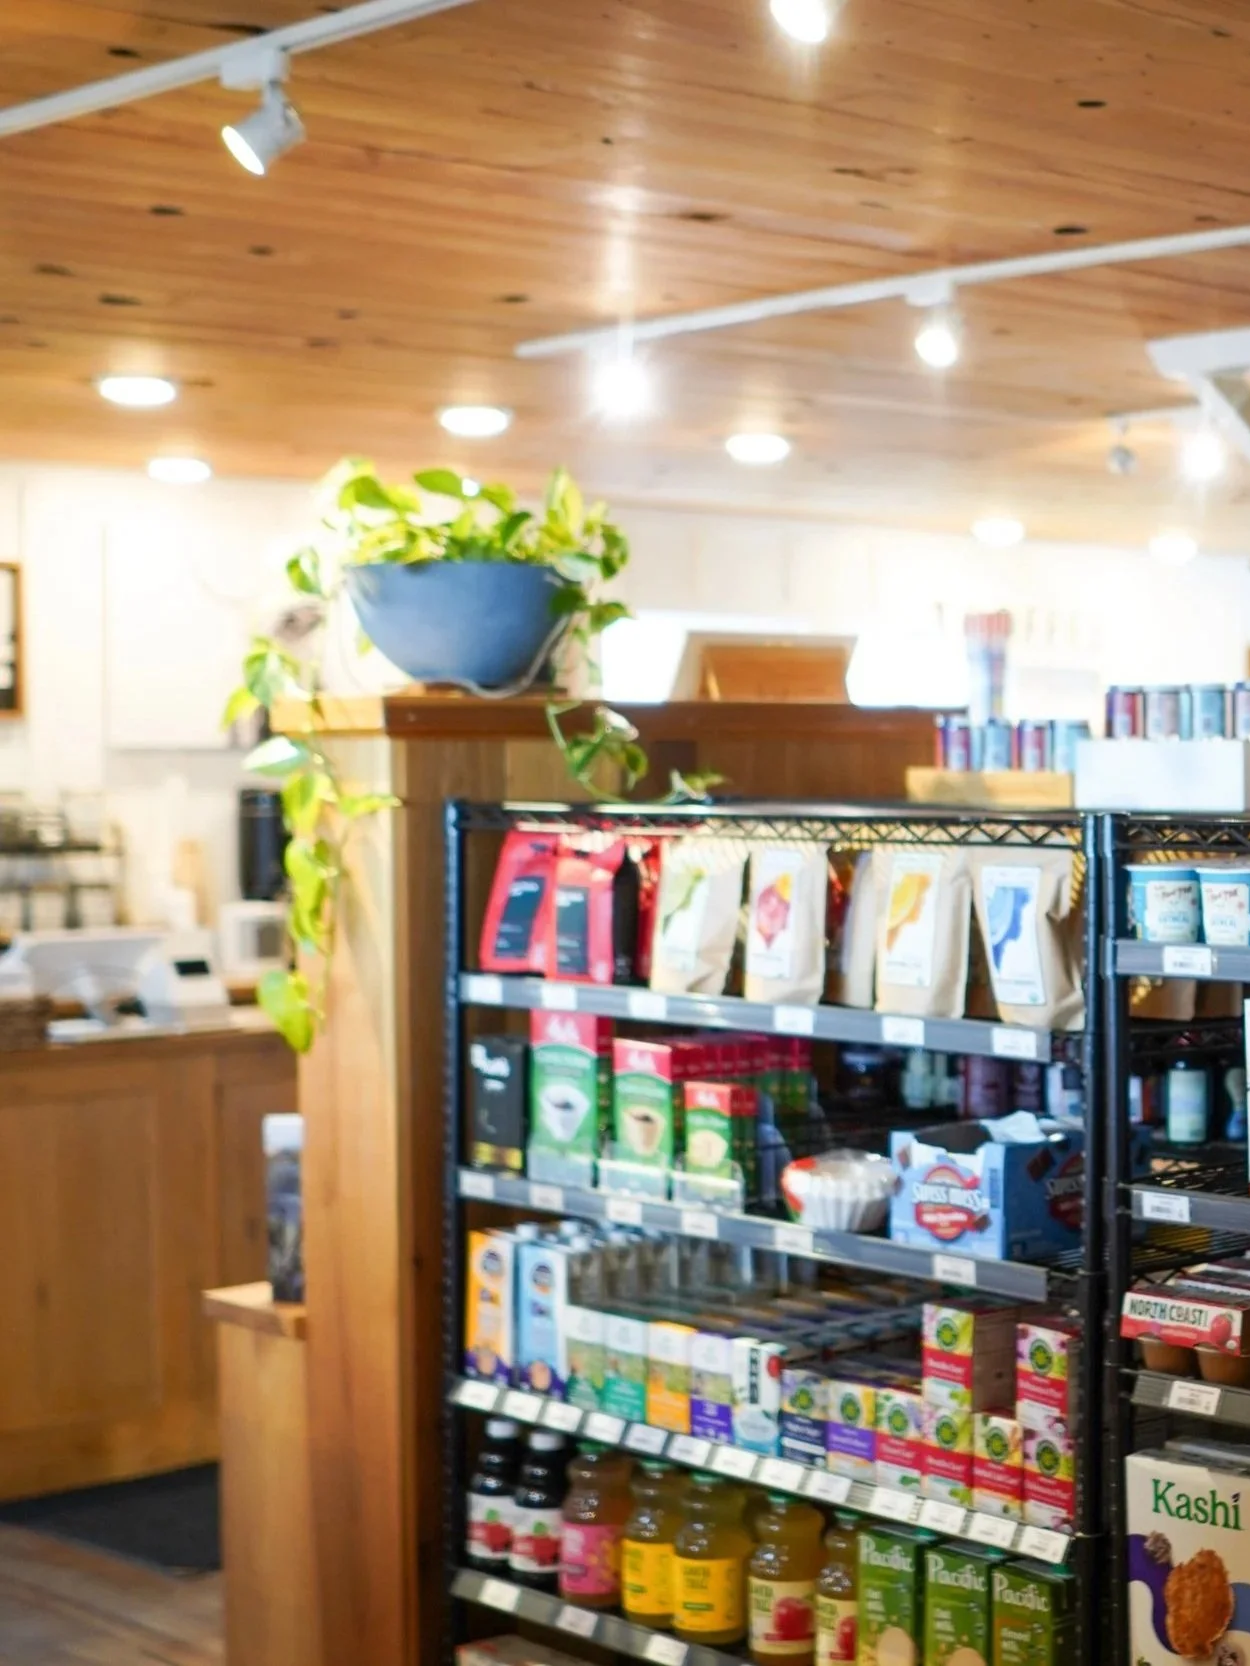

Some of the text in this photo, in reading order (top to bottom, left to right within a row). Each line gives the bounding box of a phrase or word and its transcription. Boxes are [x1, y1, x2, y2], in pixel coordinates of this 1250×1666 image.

[913, 1183, 982, 1213] SWISS MISS
[1130, 1299, 1203, 1326] NORTH COAST
[1152, 1479, 1246, 1530] Kashi
[858, 1534, 915, 1572] Pacific
[925, 1552, 987, 1592] Pacific
[992, 1571, 1050, 1612] Pacific
